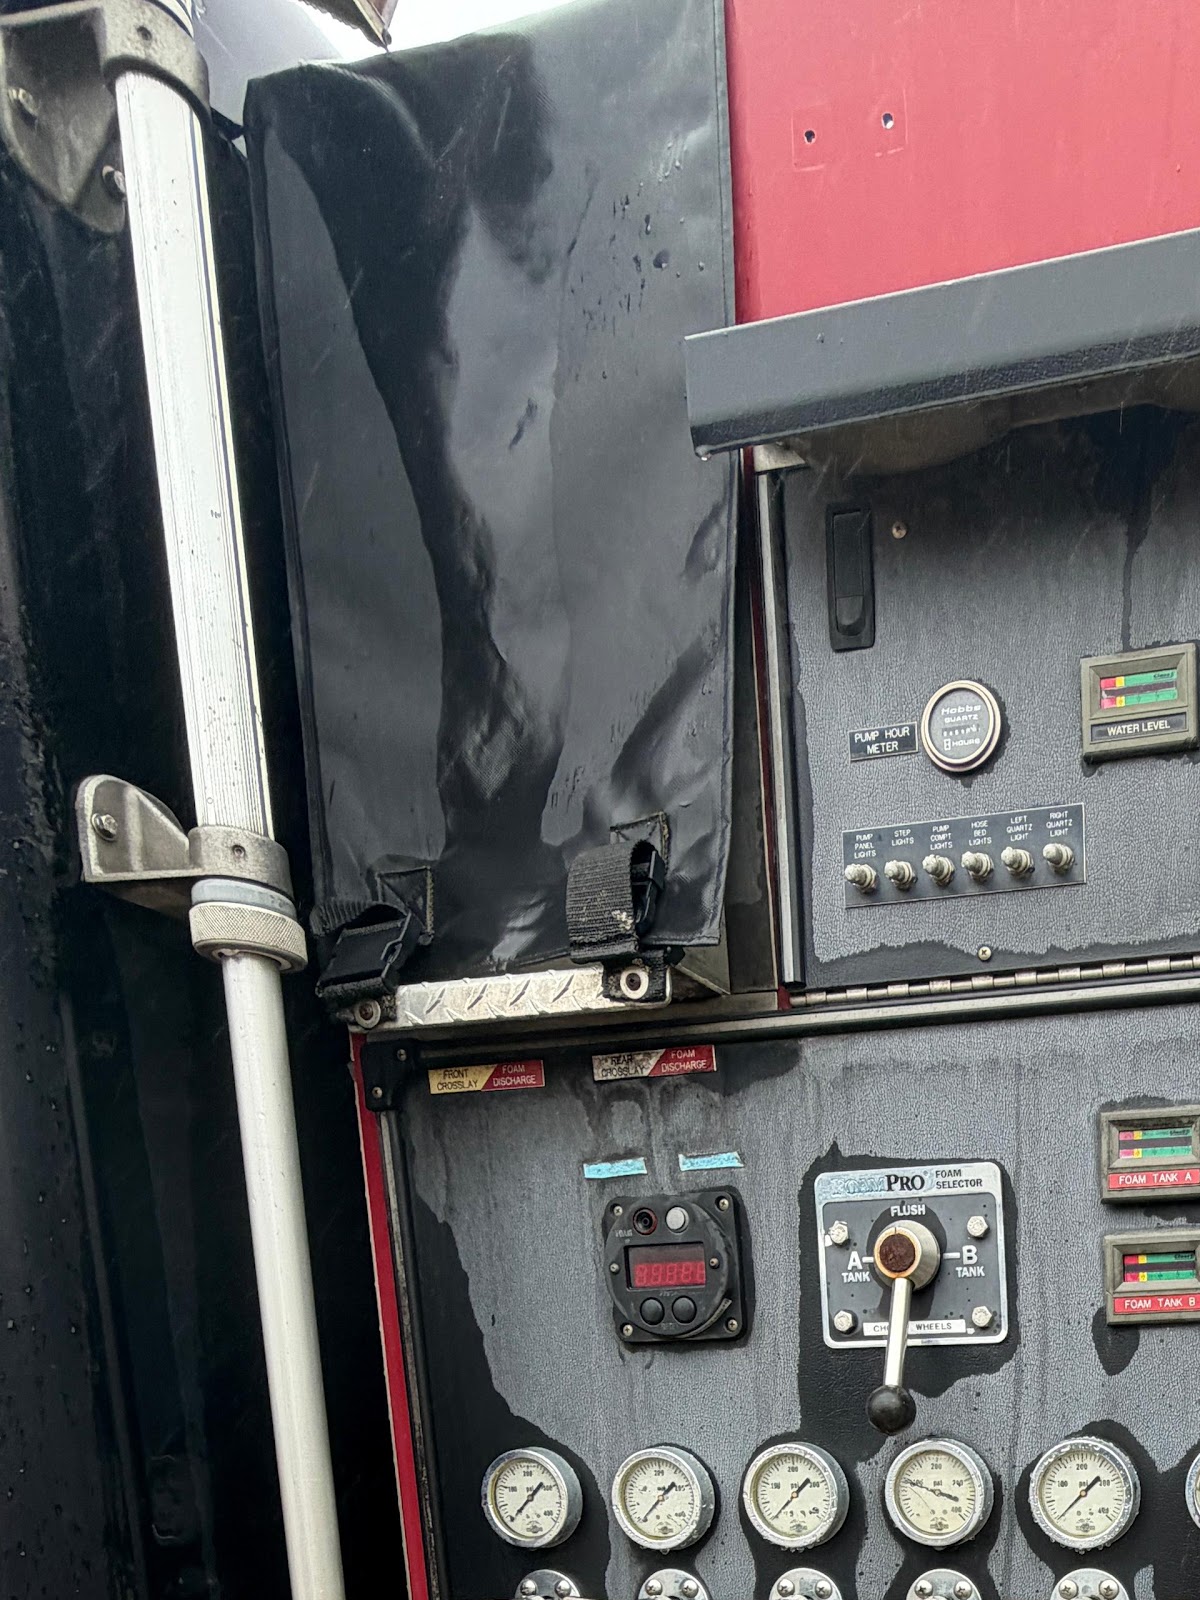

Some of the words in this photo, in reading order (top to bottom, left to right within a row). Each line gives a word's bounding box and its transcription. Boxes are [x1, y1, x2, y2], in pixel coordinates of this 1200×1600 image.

[944, 714, 978, 723] QUARTZ
[1107, 723, 1140, 736] WATER
[1141, 720, 1171, 732] LEVEL
[854, 731, 879, 743] PUMP
[884, 726, 910, 738] HOUR
[951, 738, 981, 747] HOURS
[866, 741, 899, 755] METER
[1010, 815, 1027, 824] LEFT
[1049, 811, 1069, 820] RIGHT
[932, 824, 950, 833] PUMP
[971, 820, 989, 829] HOSE
[1006, 823, 1033, 833] QUARTZ
[1045, 819, 1073, 828] QUARTZ
[855, 833, 873, 842] PUMP
[894, 829, 912, 838] STEP
[930, 833, 952, 842] COMPT
[973, 828, 987, 837] BED
[1010, 832, 1029, 841] LIGHT
[1049, 828, 1069, 838] LIGHT
[854, 842, 875, 850] PANEL
[891, 837, 914, 846] LIGHTS
[929, 842, 953, 850] LIGHTS
[968, 836, 992, 846] LIGHTS
[854, 850, 877, 859] LIGHTS
[671, 1049, 696, 1060] FOAM
[611, 1054, 634, 1066] REAR
[502, 1064, 525, 1075] FOAM
[661, 1058, 707, 1073] DISCHARGE
[443, 1069, 469, 1079] FRONT
[601, 1065, 646, 1077] CROSSLAY
[436, 1079, 479, 1091] CROSSLAY
[492, 1074, 536, 1087] DISCHARGE
[935, 1169, 962, 1179] FOAM
[1118, 1174, 1147, 1185] FOAM
[1152, 1173, 1178, 1183] TANK
[1184, 1171, 1192, 1181] A
[935, 1178, 983, 1189] SELECTOR
[890, 1204, 926, 1217] FLUSH
[847, 1250, 863, 1270] A
[962, 1245, 978, 1265] B
[841, 1271, 871, 1283] TANK
[955, 1266, 985, 1278] TANK
[1124, 1298, 1151, 1310] FOAM
[1157, 1297, 1182, 1308] TANK
[1188, 1296, 1196, 1306] B
[915, 1323, 953, 1331] WHEELS
